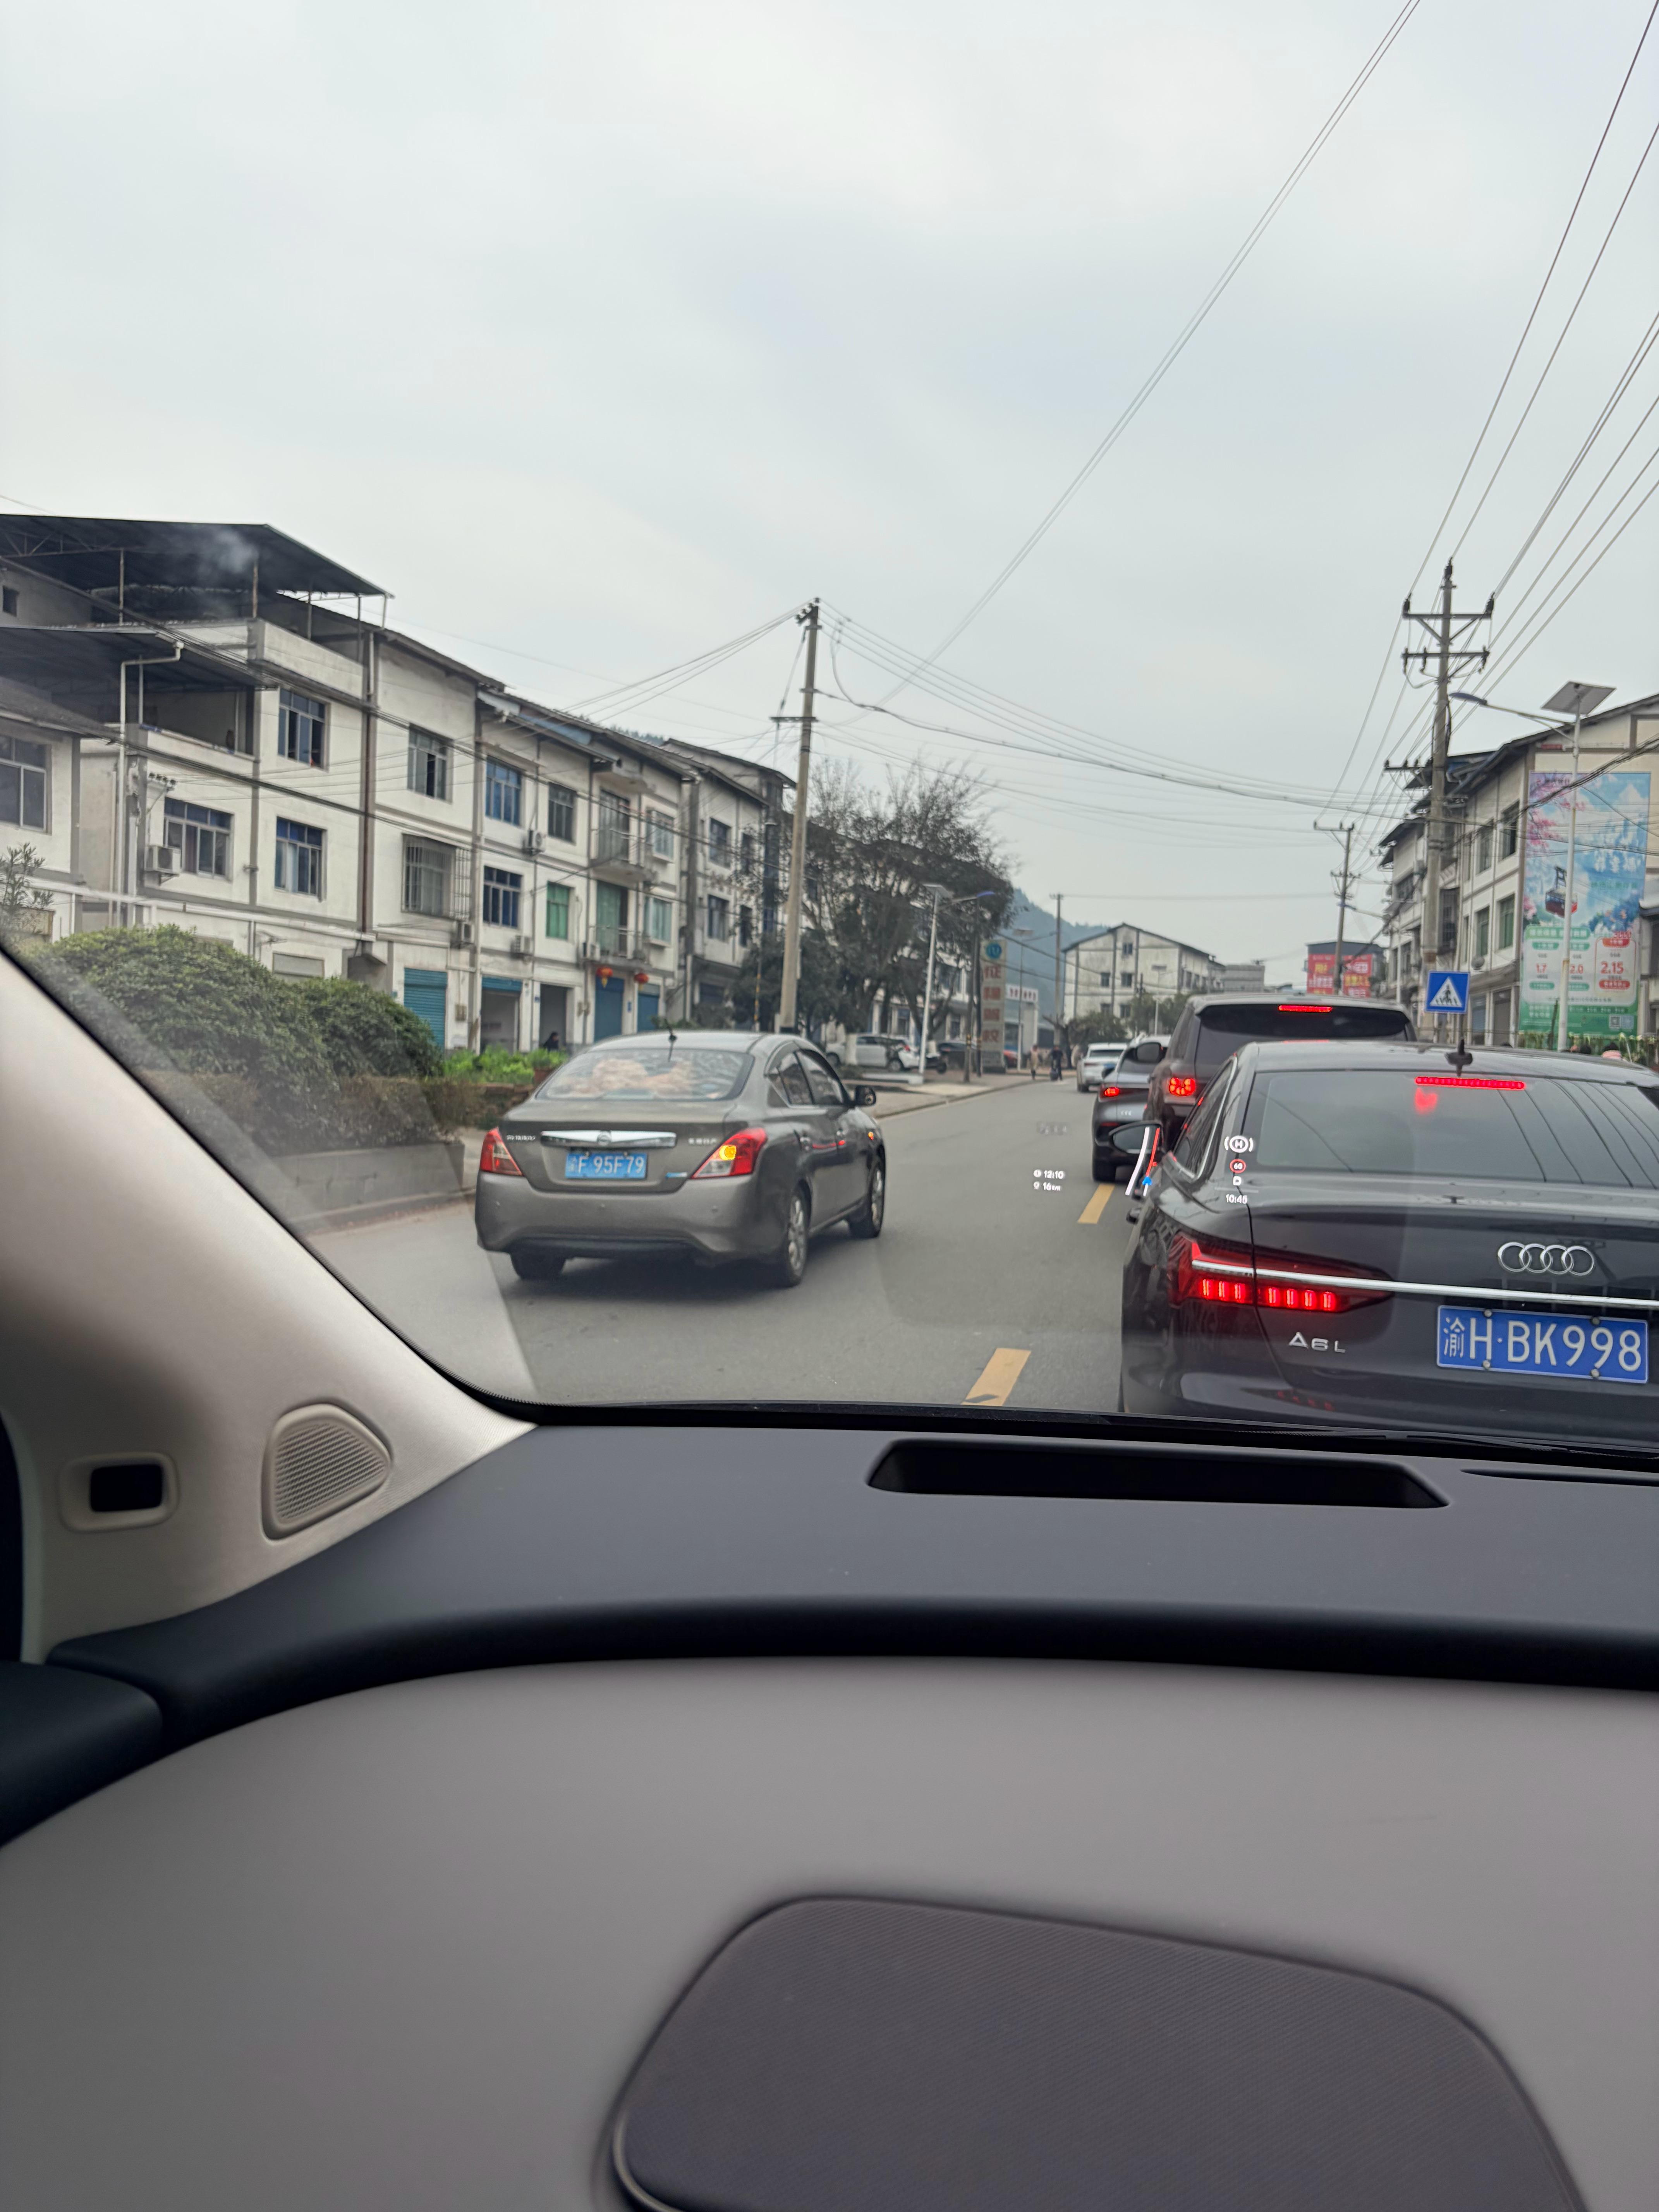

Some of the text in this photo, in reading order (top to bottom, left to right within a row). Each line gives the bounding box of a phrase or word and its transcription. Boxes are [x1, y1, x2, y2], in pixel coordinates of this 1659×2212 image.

[1570, 964, 1583, 974] 2.0
[1601, 961, 1624, 974] 2.15
[1044, 1170, 1064, 1179] 12:10
[1233, 1176, 1242, 1186] D
[1289, 1331, 1346, 1353] A6L
